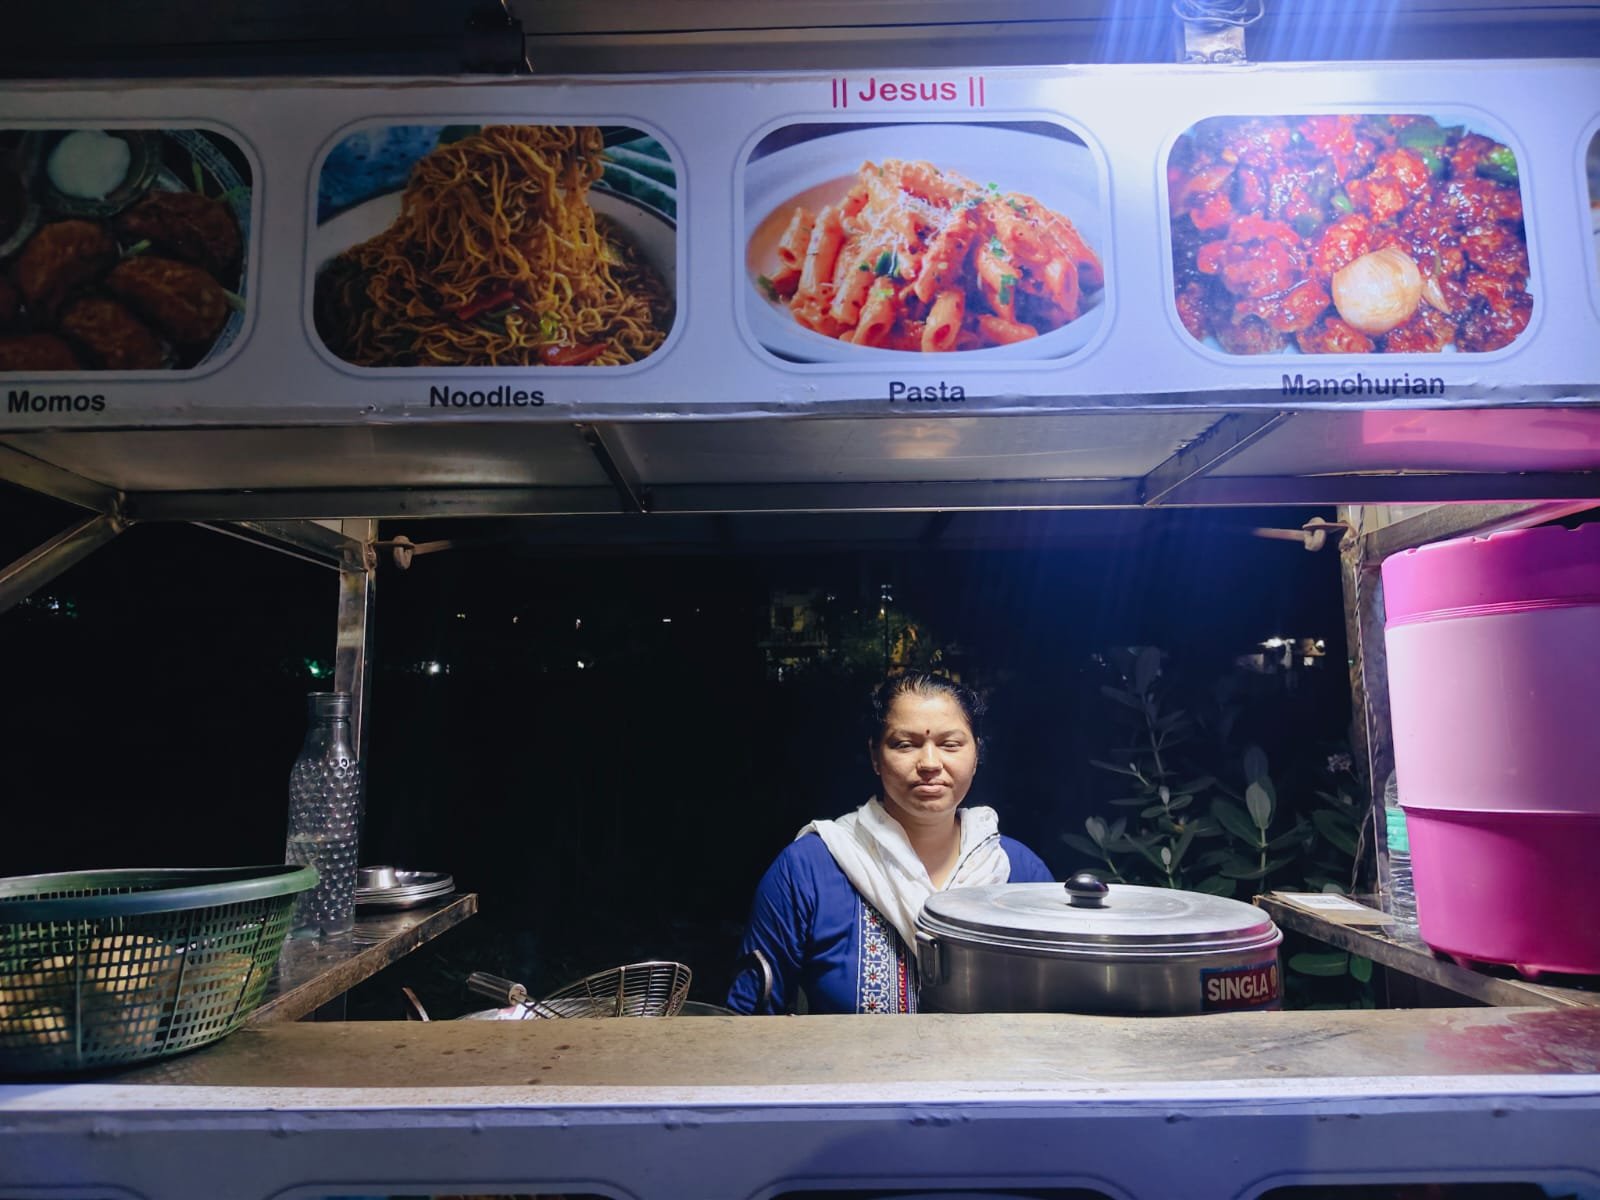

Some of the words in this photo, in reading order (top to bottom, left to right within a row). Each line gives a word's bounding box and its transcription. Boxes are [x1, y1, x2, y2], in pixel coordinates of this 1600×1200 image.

[859, 77, 957, 101] Jesus
[430, 385, 545, 407] Noodles
[889, 381, 966, 402] Pasta
[1281, 373, 1445, 396] Manchurian
[8, 390, 106, 413] Momos
[1207, 973, 1269, 1001] SINGLA
